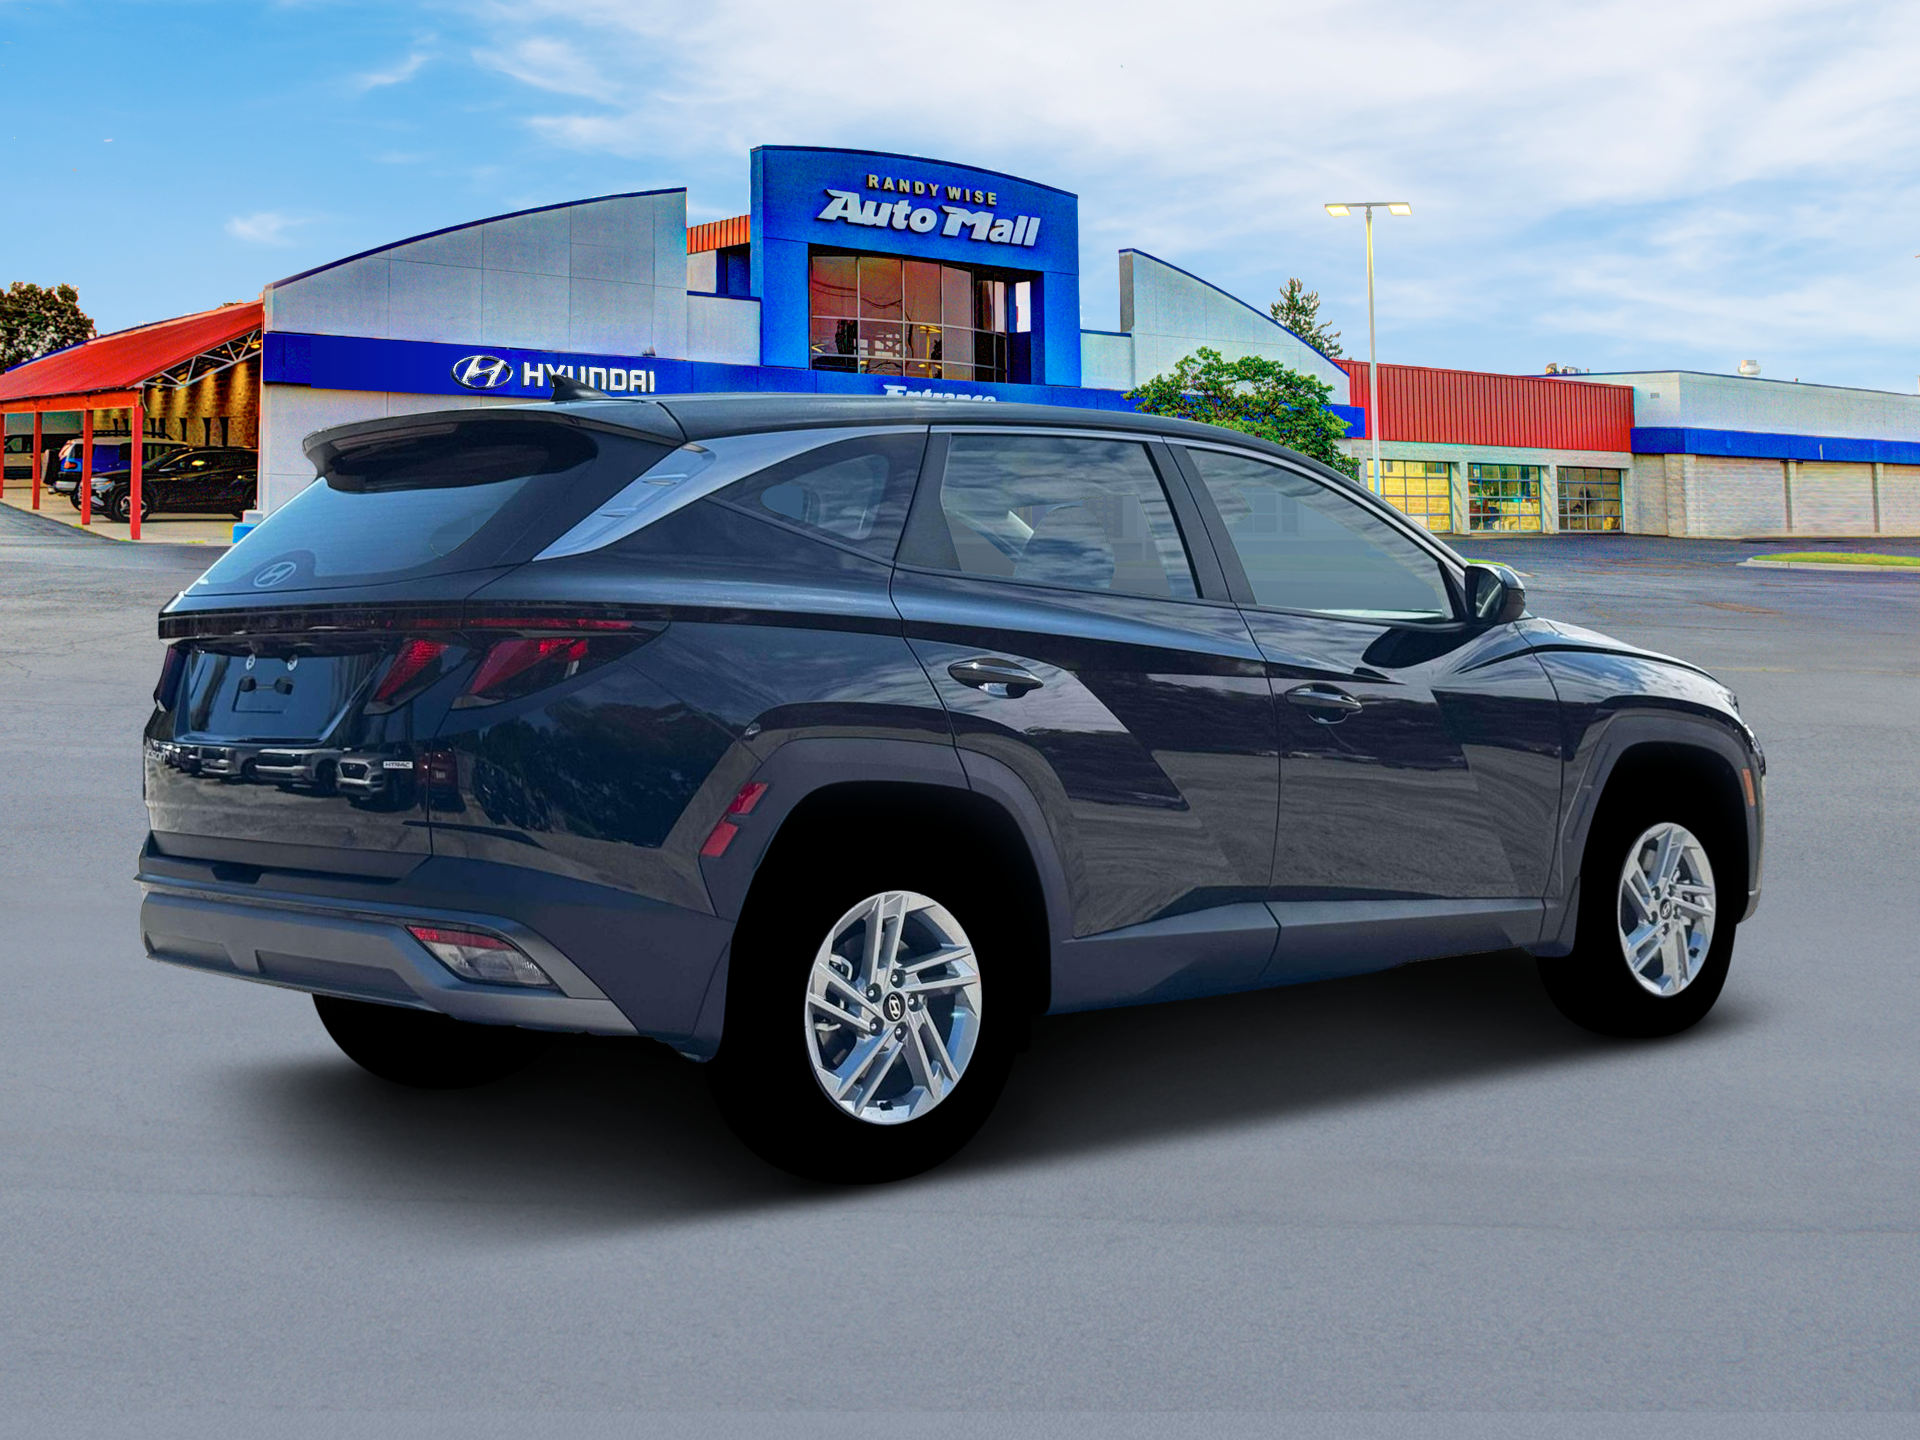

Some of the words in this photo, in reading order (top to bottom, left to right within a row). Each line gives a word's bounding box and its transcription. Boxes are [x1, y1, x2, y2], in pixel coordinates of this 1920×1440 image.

[866, 174, 939, 197] RANDY
[946, 185, 998, 206] WISE
[816, 188, 938, 233] Auto
[941, 204, 1042, 247] Mall
[522, 361, 655, 393] HYUNDAI
